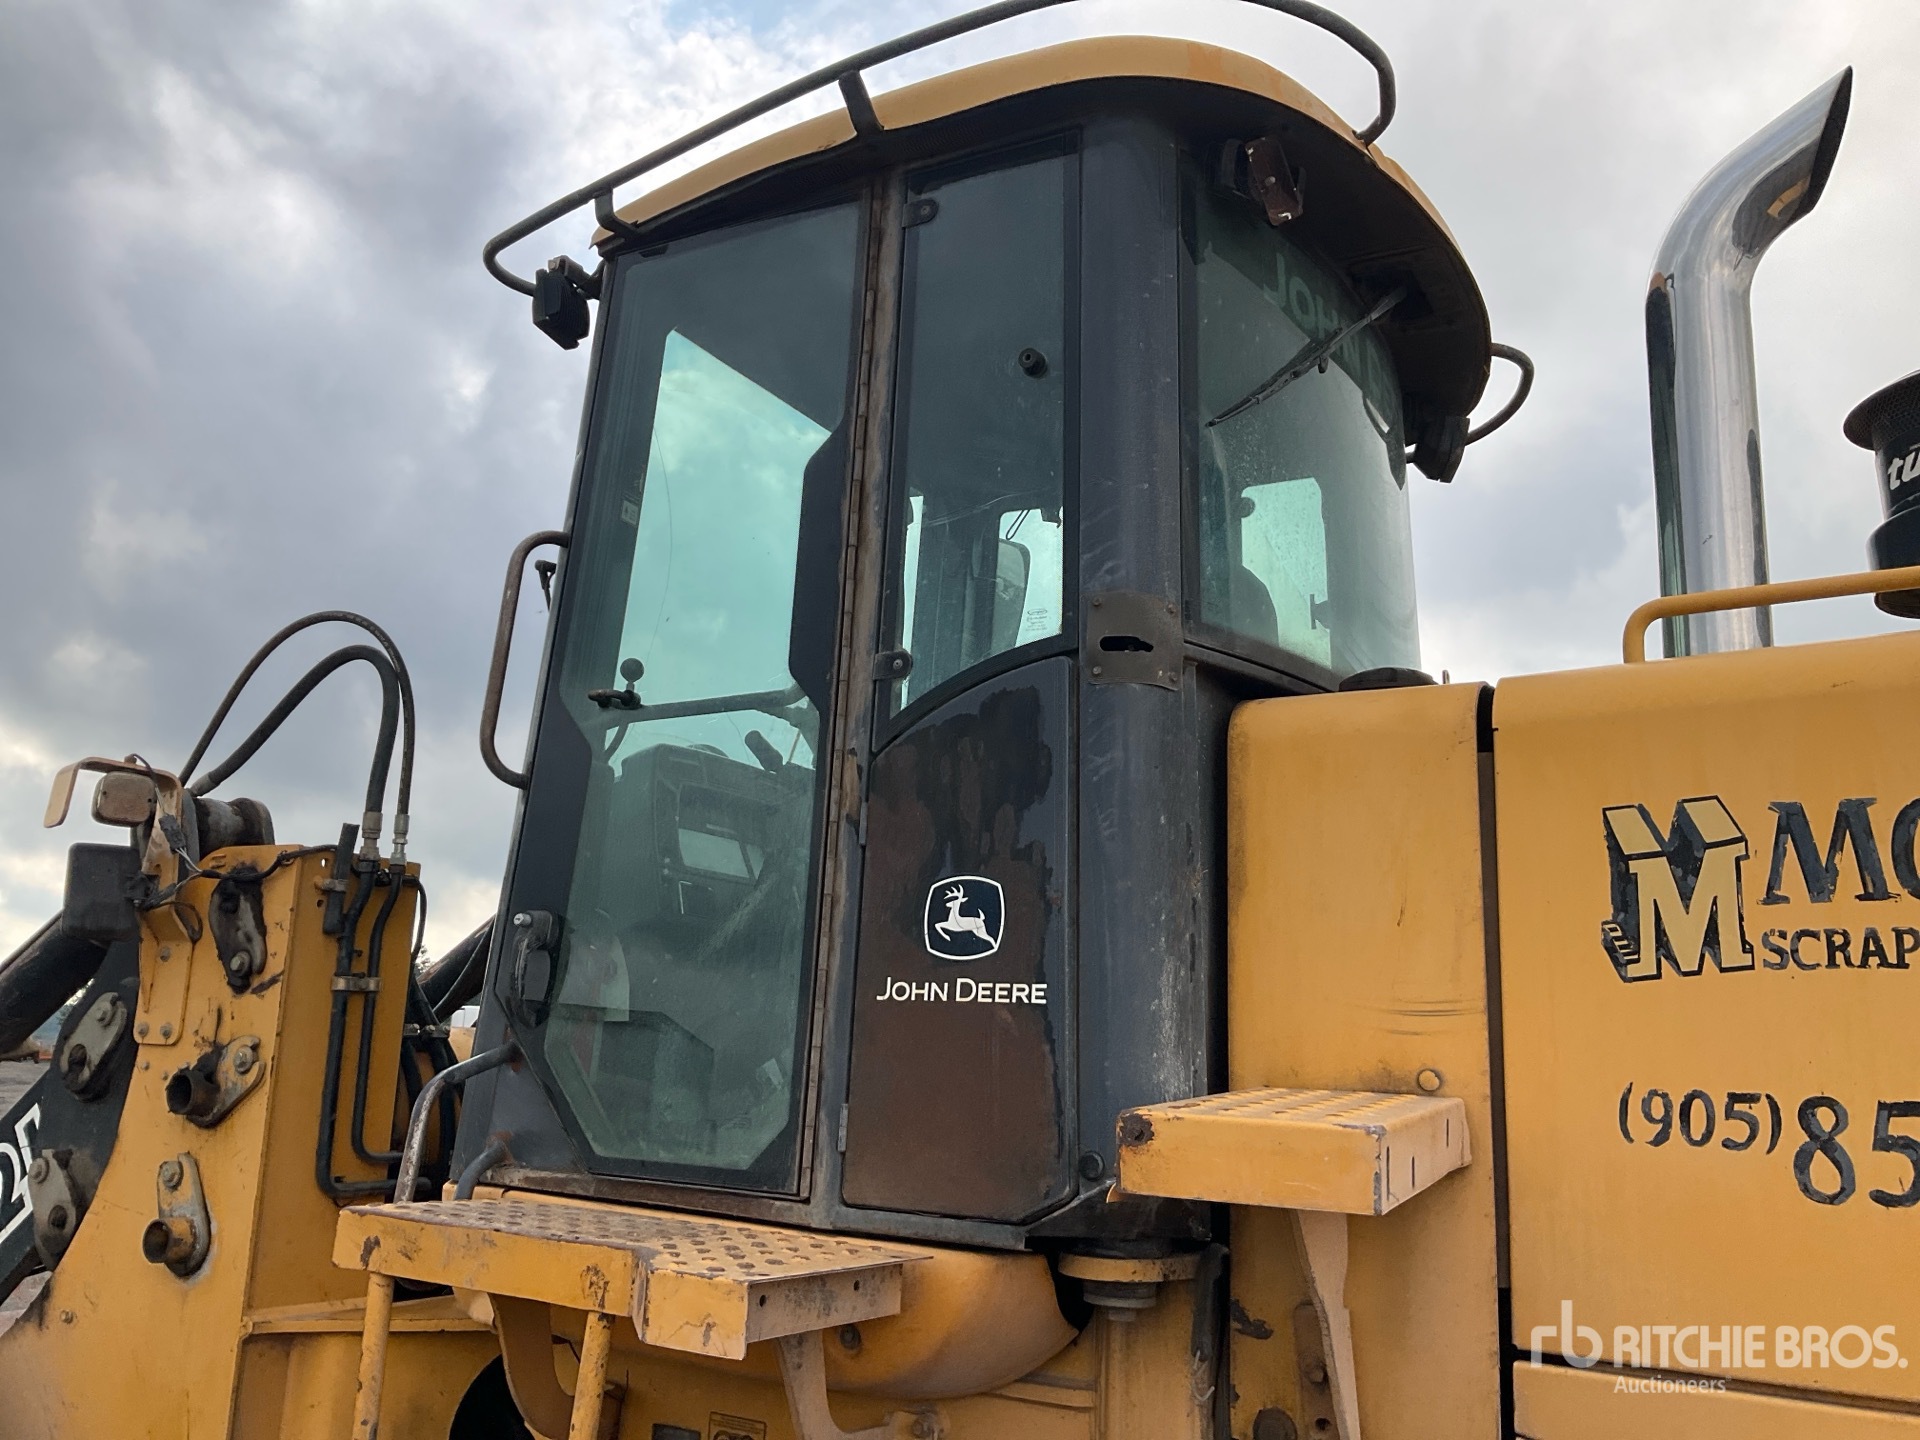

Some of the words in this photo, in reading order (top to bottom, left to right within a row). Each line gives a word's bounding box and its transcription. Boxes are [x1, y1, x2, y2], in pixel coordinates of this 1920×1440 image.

[1761, 926, 1920, 970] SCRAP
[876, 975, 949, 1002] JOHN
[955, 977, 1048, 1005] DEERE
[1617, 1081, 1783, 1156] (905)
